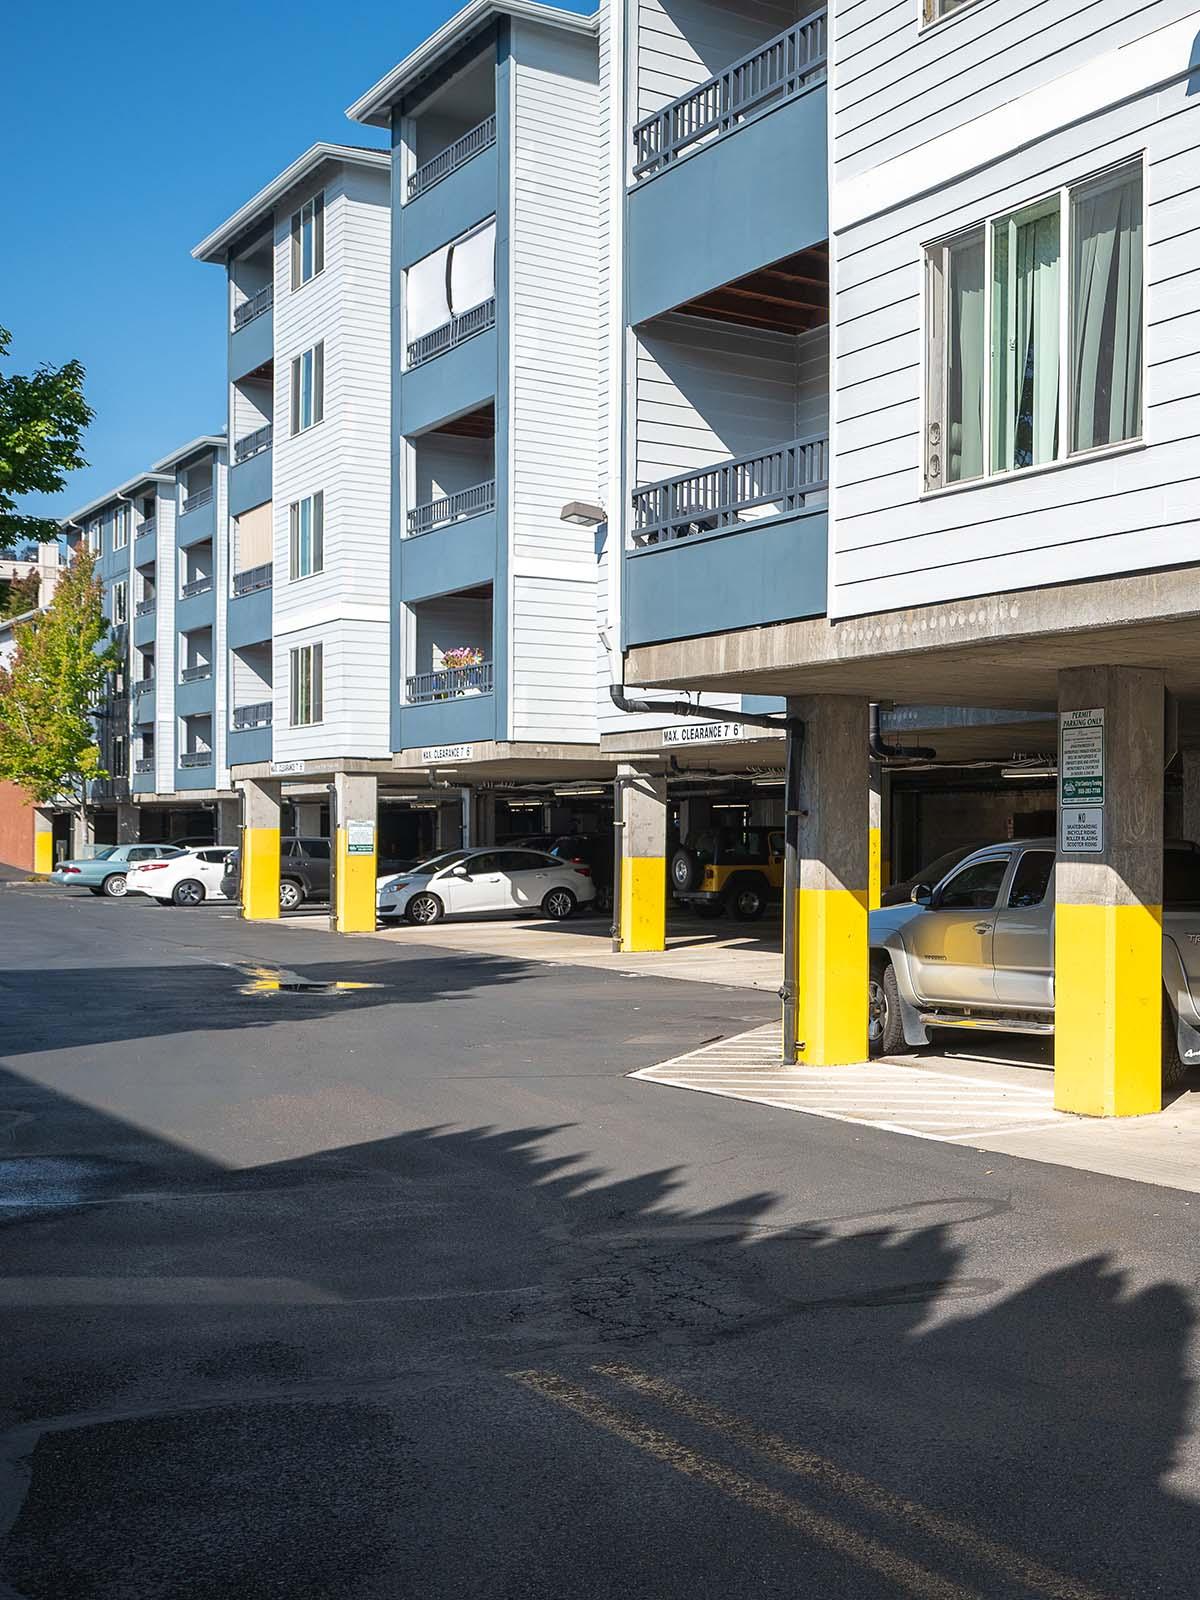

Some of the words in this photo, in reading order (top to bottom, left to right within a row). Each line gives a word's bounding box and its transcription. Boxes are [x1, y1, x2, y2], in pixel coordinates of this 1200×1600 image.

[1072, 711, 1092, 719] PERMIT
[1063, 718, 1087, 727] PARKING
[681, 725, 721, 741] CLEARANCE
[1078, 813, 1086, 823] NO
